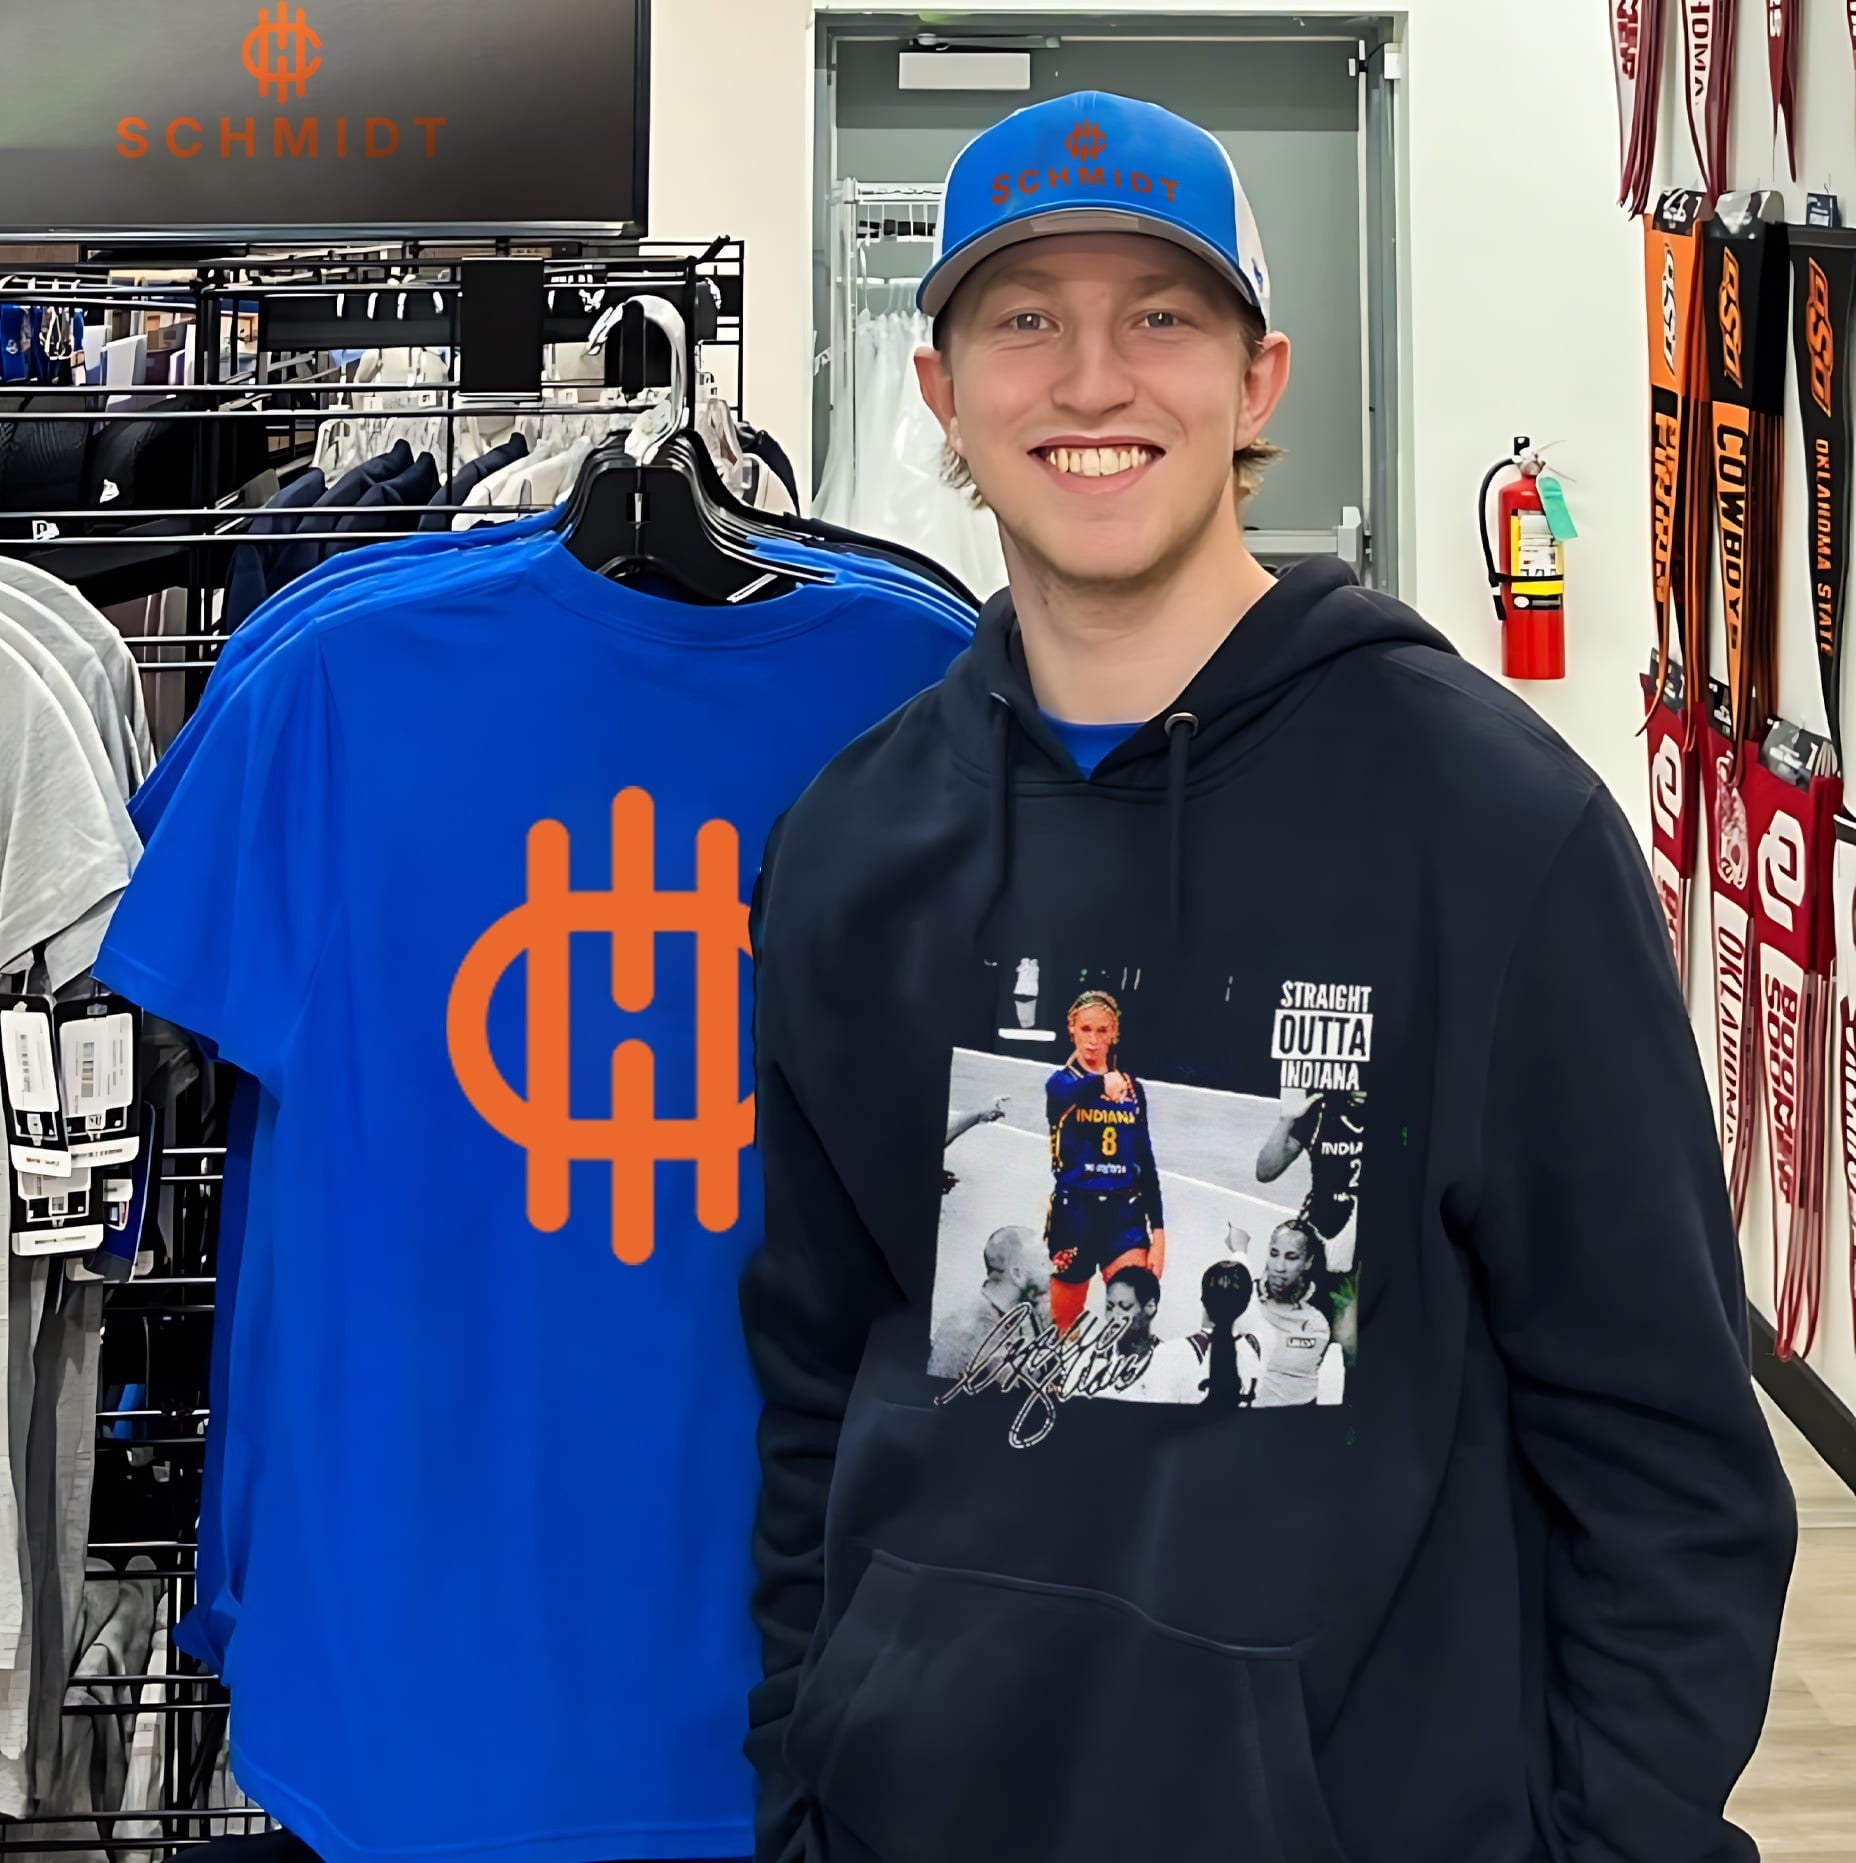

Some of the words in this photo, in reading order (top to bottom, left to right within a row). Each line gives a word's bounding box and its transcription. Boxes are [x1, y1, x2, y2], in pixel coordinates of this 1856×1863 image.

[115, 115, 448, 159] SCHMIDT
[991, 166, 1179, 205] SCHMIDT
[1280, 980, 1372, 1013] STRAIGHT
[1278, 1014, 1367, 1057] OUTTA
[1280, 1060, 1360, 1091] INDIANA
[1101, 1126, 1118, 1157] 8
[1348, 1158, 1362, 1188] 2
